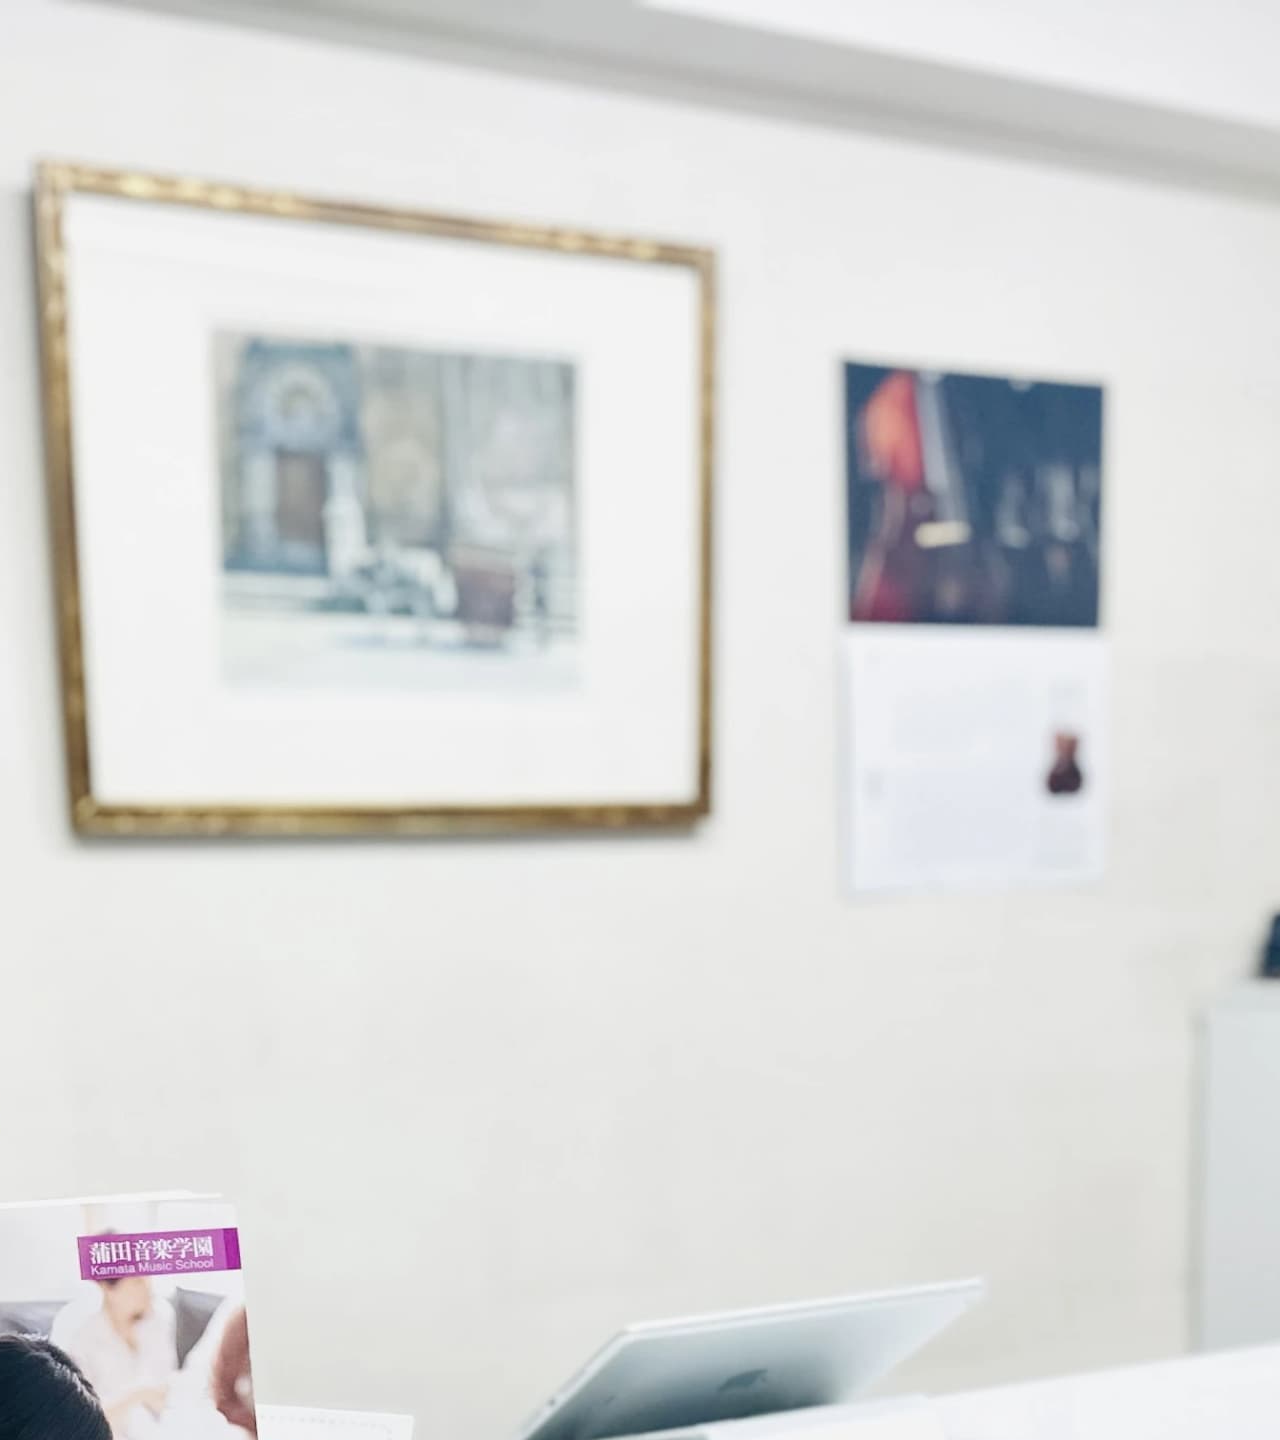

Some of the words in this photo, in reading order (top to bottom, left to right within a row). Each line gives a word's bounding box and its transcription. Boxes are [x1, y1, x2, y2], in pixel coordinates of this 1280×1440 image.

[89, 1236, 214, 1264] 蒲田音楽学園
[91, 1264, 136, 1276] Kamata
[138, 1261, 173, 1273] Music
[175, 1258, 215, 1270] School
